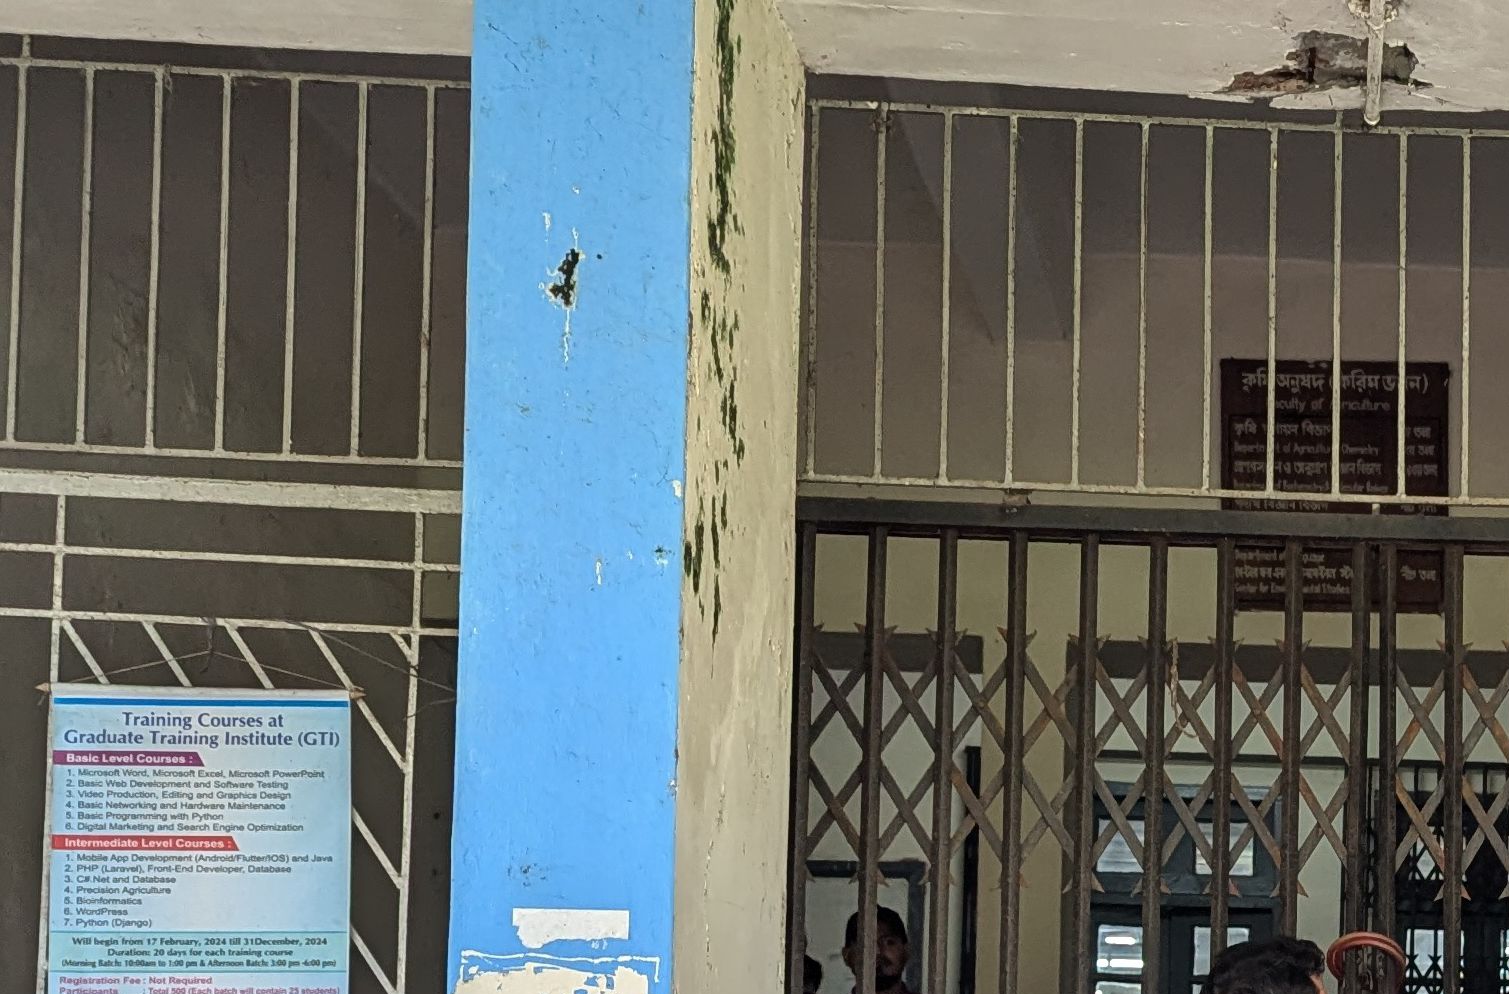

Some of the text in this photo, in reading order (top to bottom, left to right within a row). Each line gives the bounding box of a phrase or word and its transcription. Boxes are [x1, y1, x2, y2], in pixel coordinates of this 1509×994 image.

[1382, 373, 1429, 394] ভন)
[121, 711, 283, 730] Training Courses at
[63, 728, 339, 748] Graduate Training Institute (GTI)
[66, 753, 186, 763] Basic Level Courses
[67, 768, 75, 776] 1.
[77, 767, 120, 777] Microsoft
[152, 768, 195, 777] Microsoft
[228, 769, 270, 778] Microsoft
[272, 769, 325, 778] PowerPoint
[65, 778, 289, 790] 2. Basic Web Development and Software Testing
[65, 789, 75, 798] 3.
[77, 789, 104, 798] Video
[161, 789, 193, 800] Editing
[195, 791, 213, 799] and
[215, 790, 257, 800] Graphics
[259, 790, 291, 801] Design
[64, 800, 286, 810] 4. Basic Networking and Hardware Maintenance
[77, 811, 103, 820] Basic
[105, 811, 168, 821] Programming
[169, 812, 189, 820] with
[191, 811, 224, 821] Python
[76, 821, 107, 832] Digital
[108, 822, 155, 832] Marketing
[156, 822, 174, 831] and
[176, 822, 210, 831] Search
[212, 822, 245, 833] Engine
[246, 822, 303, 833] Optimization
[64, 837, 224, 848] Intermediate Level Courses
[65, 853, 74, 861] 1.
[76, 852, 108, 861] Mobile
[109, 853, 129, 862] App
[130, 853, 193, 863] Development
[291, 853, 309, 862] and
[310, 854, 333, 862] Java
[64, 863, 73, 872] 2.
[76, 863, 99, 872] PHP
[147, 864, 193, 873] Front-End
[247, 864, 291, 873] Database
[63, 874, 73, 883] 3.
[111, 875, 129, 883] and
[131, 875, 176, 883] Database
[63, 885, 171, 895] 4. Precision Agriculture
[75, 896, 142, 905] Bioinformatics
[75, 907, 128, 915] WordPress
[63, 917, 152, 928] 7. Python (Django)
[71, 936, 92, 945] Will
[93, 936, 119, 946] begin
[121, 936, 143, 945] from
[146, 937, 157, 945] 17
[203, 937, 227, 945] 2024
[228, 937, 241, 945] till
[304, 937, 327, 945] 2024
[107, 947, 150, 956] Duration:
[153, 948, 165, 956] 20
[166, 947, 187, 957] days
[188, 947, 202, 956] for
[204, 947, 225, 956] each
[227, 947, 262, 957] training
[59, 975, 213, 986] Registration Fee Not Required
